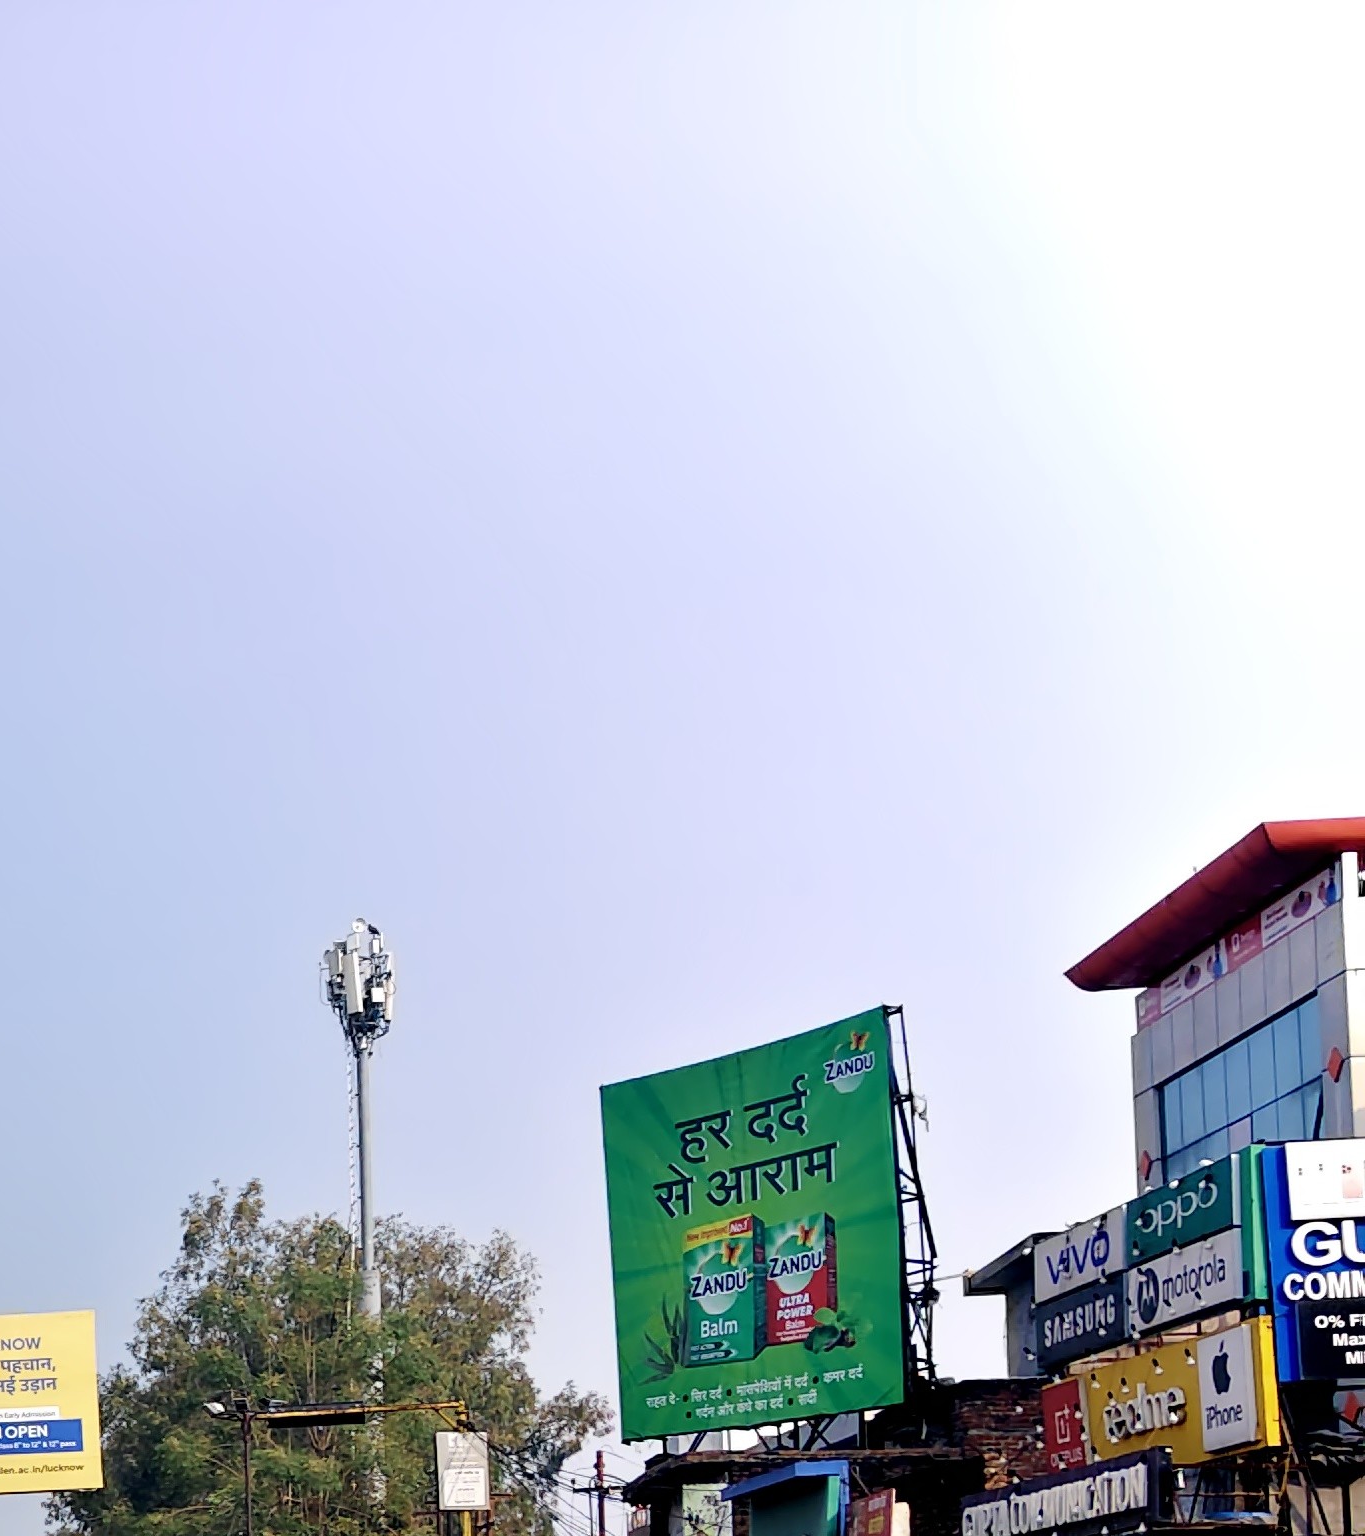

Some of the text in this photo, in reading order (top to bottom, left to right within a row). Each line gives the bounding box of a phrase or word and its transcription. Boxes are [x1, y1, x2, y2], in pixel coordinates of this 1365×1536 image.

[825, 1052, 874, 1083] ZANDU
[675, 1074, 809, 1163] हर दर्द
[653, 1141, 840, 1218] से आराम
[1139, 1182, 1218, 1237] oppo
[769, 1249, 824, 1280] ZANDU
[1162, 1253, 1226, 1303] motorola
[691, 1269, 748, 1299] ZANDU
[777, 1305, 814, 1320] POWER
[779, 1293, 810, 1308] ULTRA
[700, 1318, 738, 1338] Balm
[1044, 1294, 1116, 1348] SAMSUNG
[1314, 1314, 1346, 1329] 0%
[1, 1357, 56, 1375] पहचान,
[794, 1374, 808, 1389] दर्द
[848, 1363, 864, 1380] दर्द
[19, 1377, 58, 1395] उड़ान
[5, 1424, 48, 1438] OPEN
[1205, 1402, 1243, 1431] iPhone
